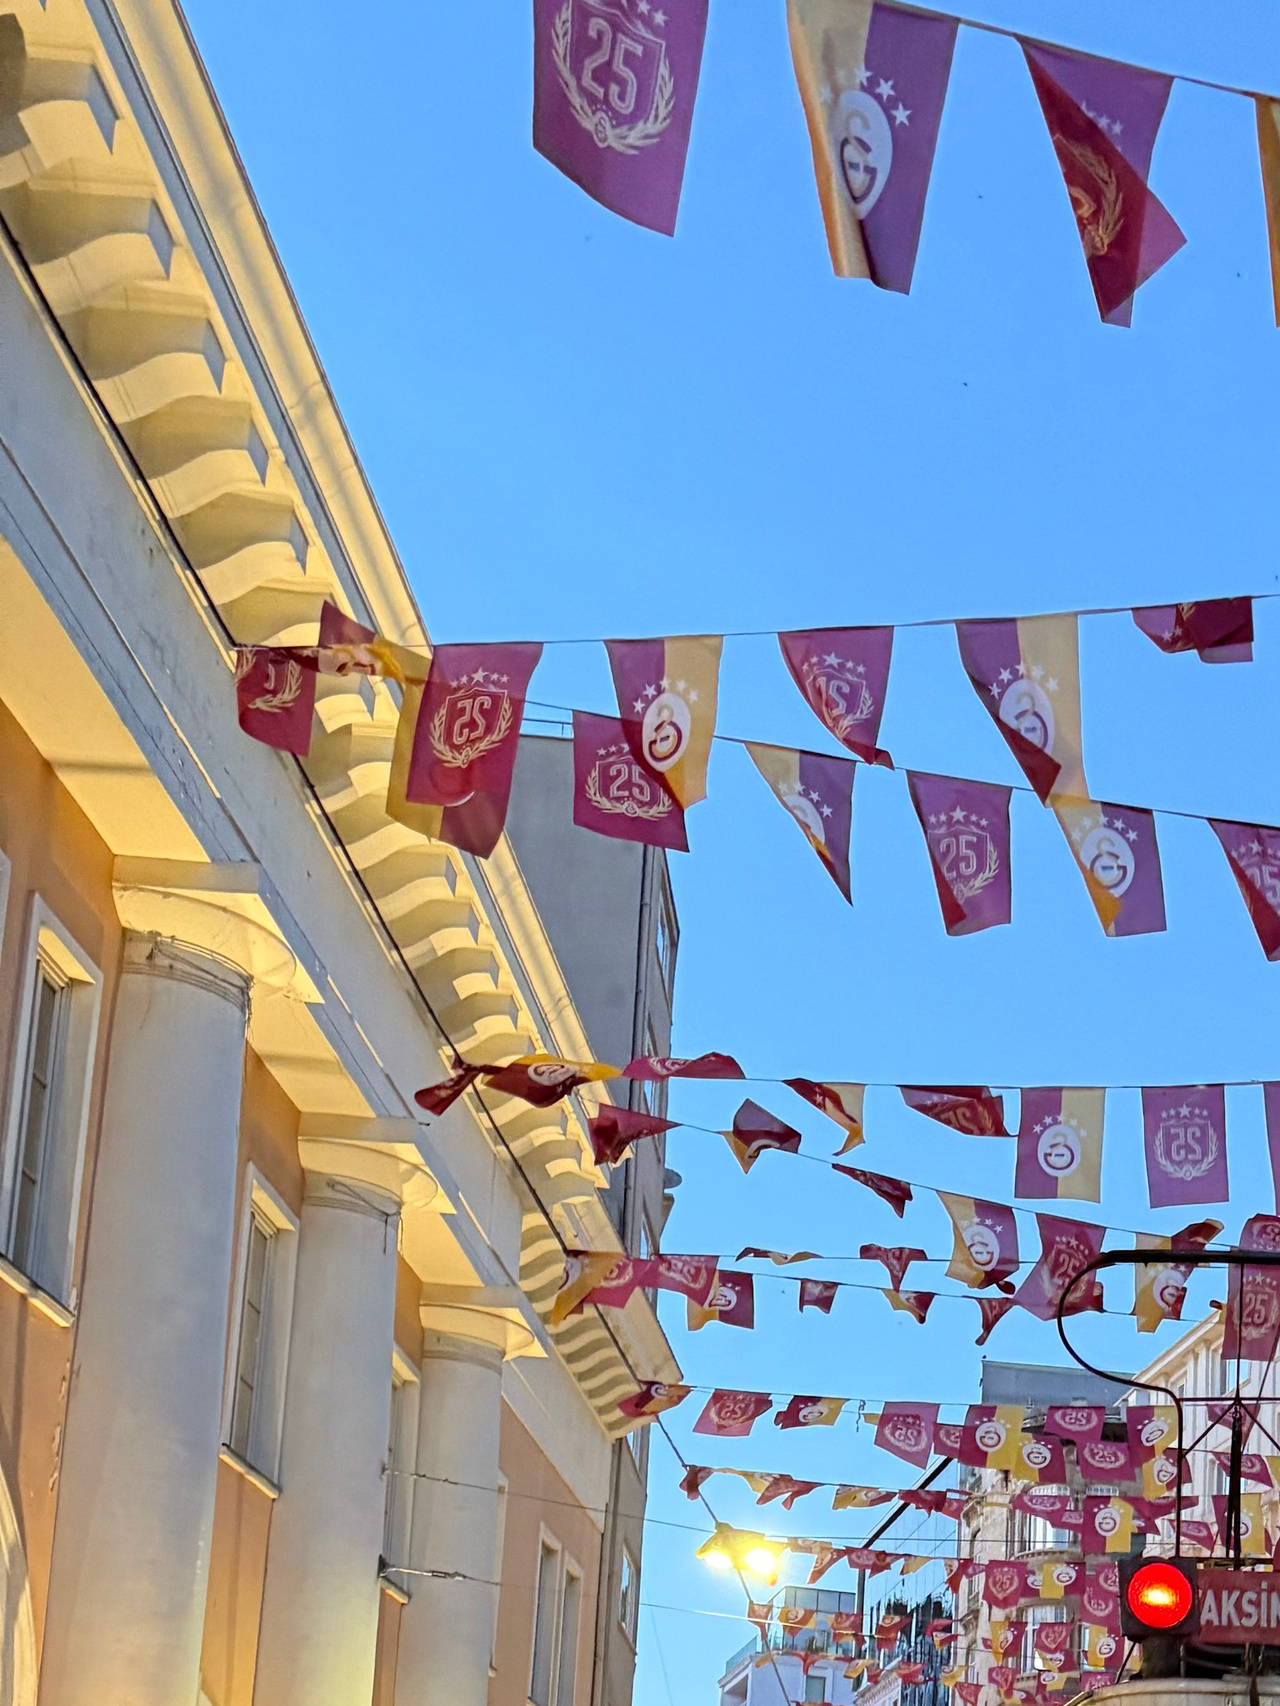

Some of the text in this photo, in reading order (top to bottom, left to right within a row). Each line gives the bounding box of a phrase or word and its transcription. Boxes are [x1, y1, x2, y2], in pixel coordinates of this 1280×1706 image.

[581, 17, 643, 115] 25
[609, 763, 651, 802] 25
[939, 834, 978, 880] 25
[1243, 1293, 1268, 1324] 25
